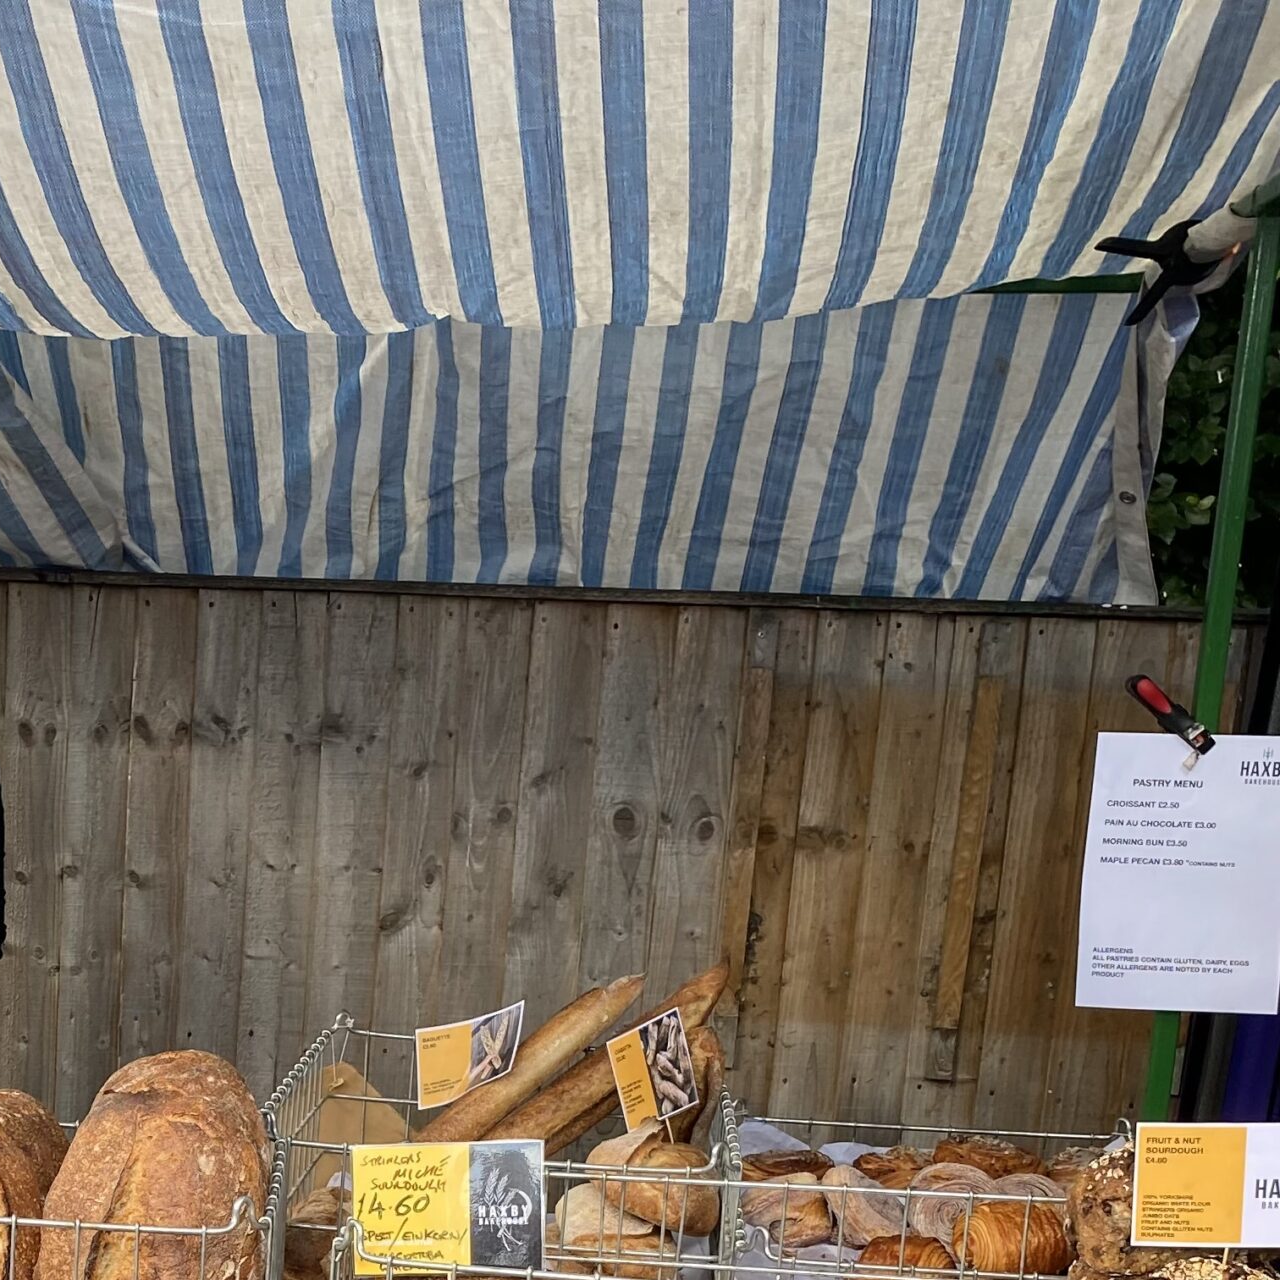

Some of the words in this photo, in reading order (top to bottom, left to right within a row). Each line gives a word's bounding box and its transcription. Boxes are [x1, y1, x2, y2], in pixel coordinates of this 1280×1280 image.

[1133, 778, 1171, 788] PASTRY
[1173, 780, 1204, 789] MENU
[1106, 800, 1156, 808] CROISSANT
[1158, 801, 1180, 809] £2.50
[1104, 819, 1124, 827] PAIN
[1126, 819, 1138, 827] AU
[1140, 820, 1193, 829] CHOCOLATE
[1194, 821, 1217, 829] £3.00
[1102, 837, 1144, 846] MORNING
[1145, 839, 1164, 847] BUN
[1100, 856, 1129, 865] MAPLE
[1131, 857, 1160, 866] PECAN
[1092, 946, 1134, 954] ALLERGENS
[1091, 954, 1105, 962] ALL
[1106, 955, 1139, 963] PASTRIES
[1140, 956, 1172, 964] CONTAIN
[1091, 962, 1115, 970] OTHER
[1116, 963, 1158, 972] ALLERGENS
[1091, 970, 1124, 978] PRODUCT
[1146, 1137, 1172, 1145] FRUIT
[1174, 1137, 1181, 1145] &
[1182, 1137, 1202, 1145] NUT
[1145, 1147, 1204, 1155] SOURDOUGH
[478, 1204, 529, 1218] HAXBY
